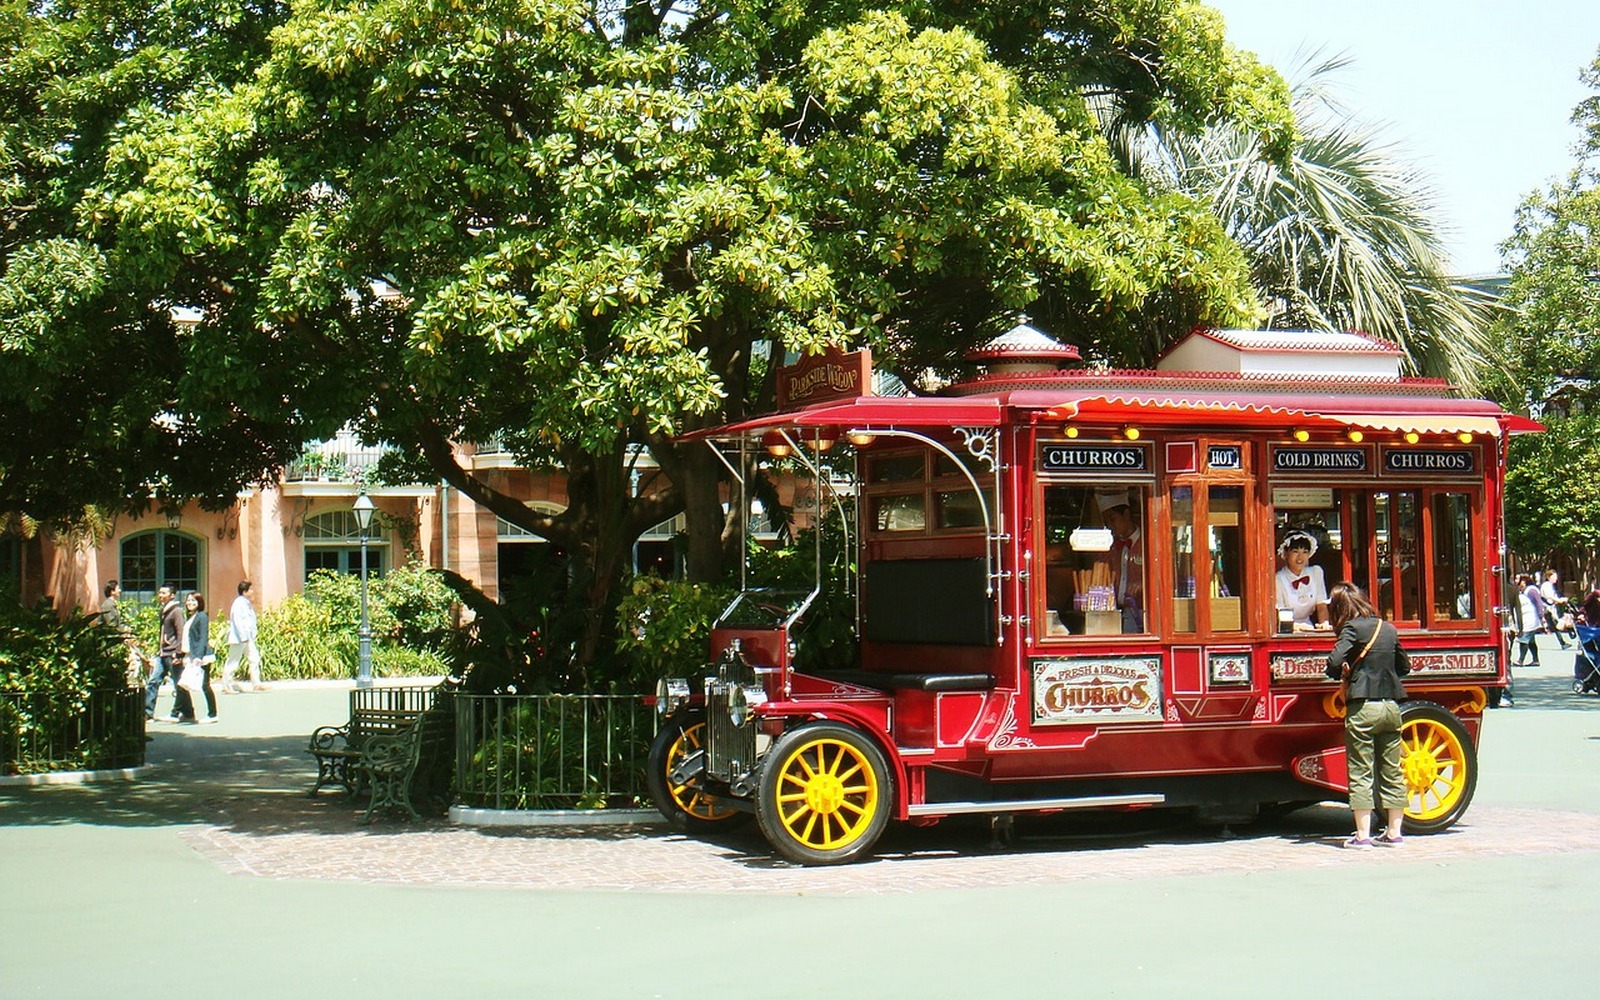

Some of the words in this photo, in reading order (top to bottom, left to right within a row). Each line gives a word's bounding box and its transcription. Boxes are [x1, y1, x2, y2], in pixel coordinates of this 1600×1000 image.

[826, 364, 858, 391] WAGON
[1049, 450, 1136, 466] CHURROS
[1211, 450, 1234, 465] HOT
[1277, 452, 1311, 467] COLD
[1314, 452, 1360, 467] DRINKS
[1391, 454, 1466, 468] CHURROS
[1284, 659, 1326, 675] DISNE
[1445, 654, 1487, 670] SMILE
[1058, 665, 1092, 680] FRESH
[1044, 680, 1151, 712] CHURROS
